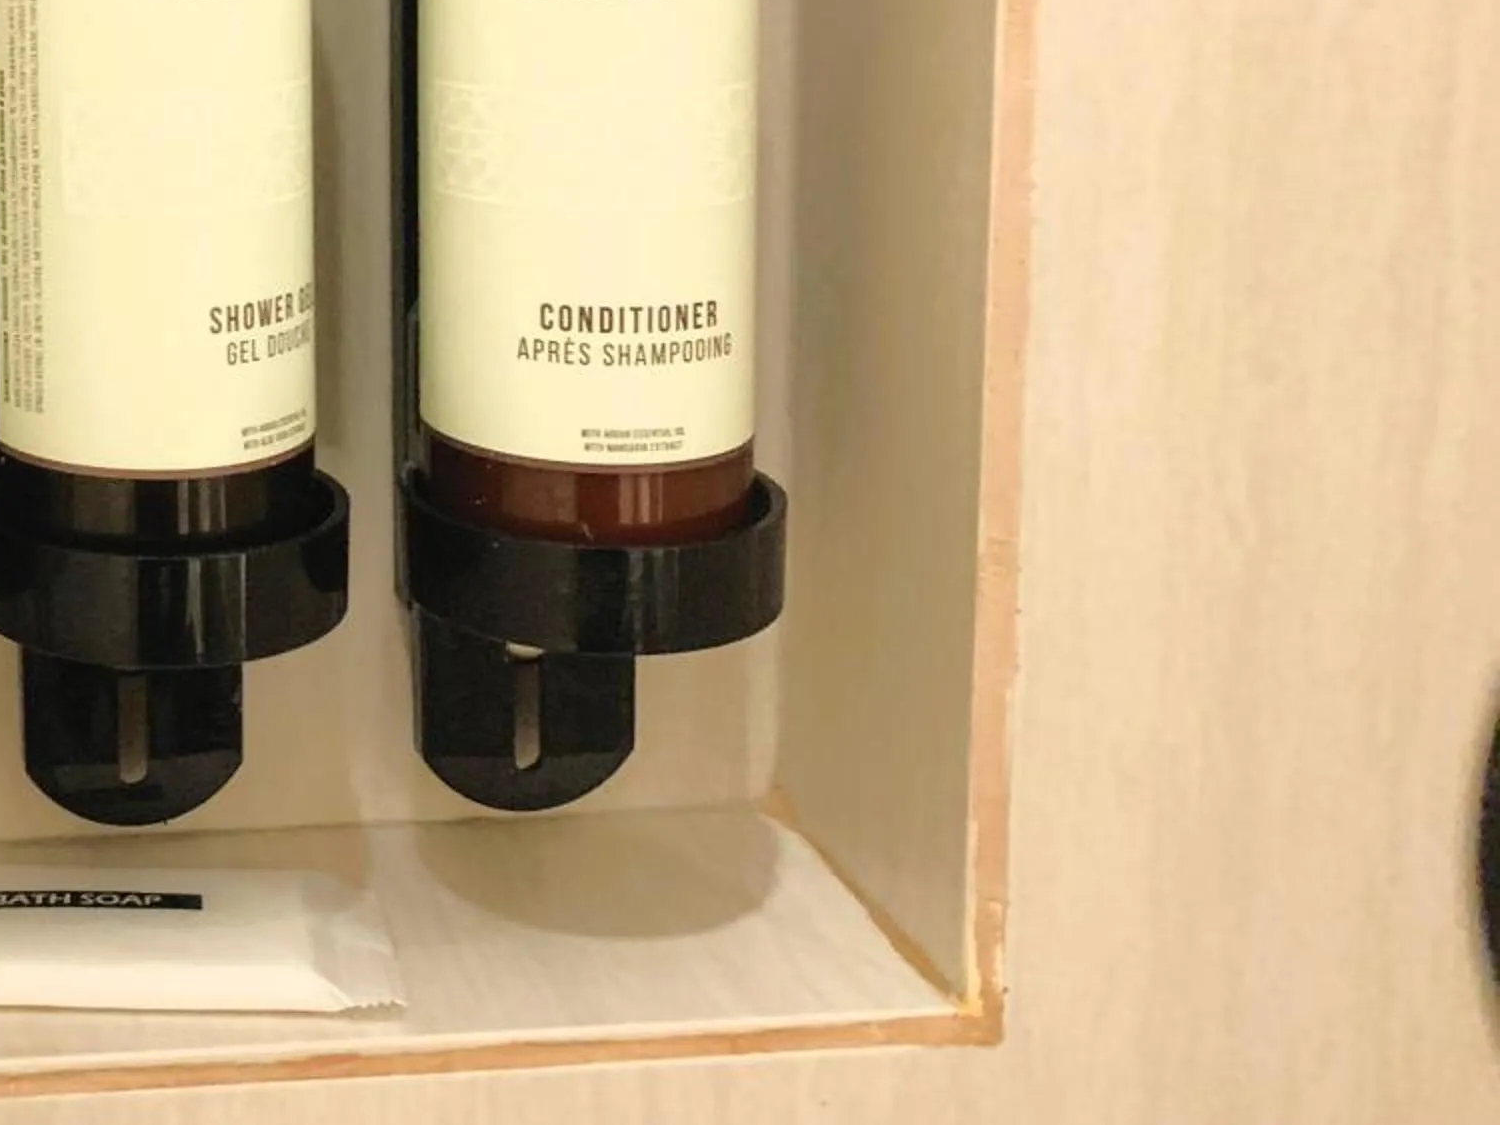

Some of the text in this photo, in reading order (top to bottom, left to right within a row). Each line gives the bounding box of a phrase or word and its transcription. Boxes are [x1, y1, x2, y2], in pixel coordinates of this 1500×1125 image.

[209, 292, 294, 335] SHOWER
[539, 299, 718, 334] CONDITIONER
[226, 338, 261, 366] GEL
[517, 331, 733, 367] APRÈS SHAMPOOING
[79, 892, 163, 906] SOAP
